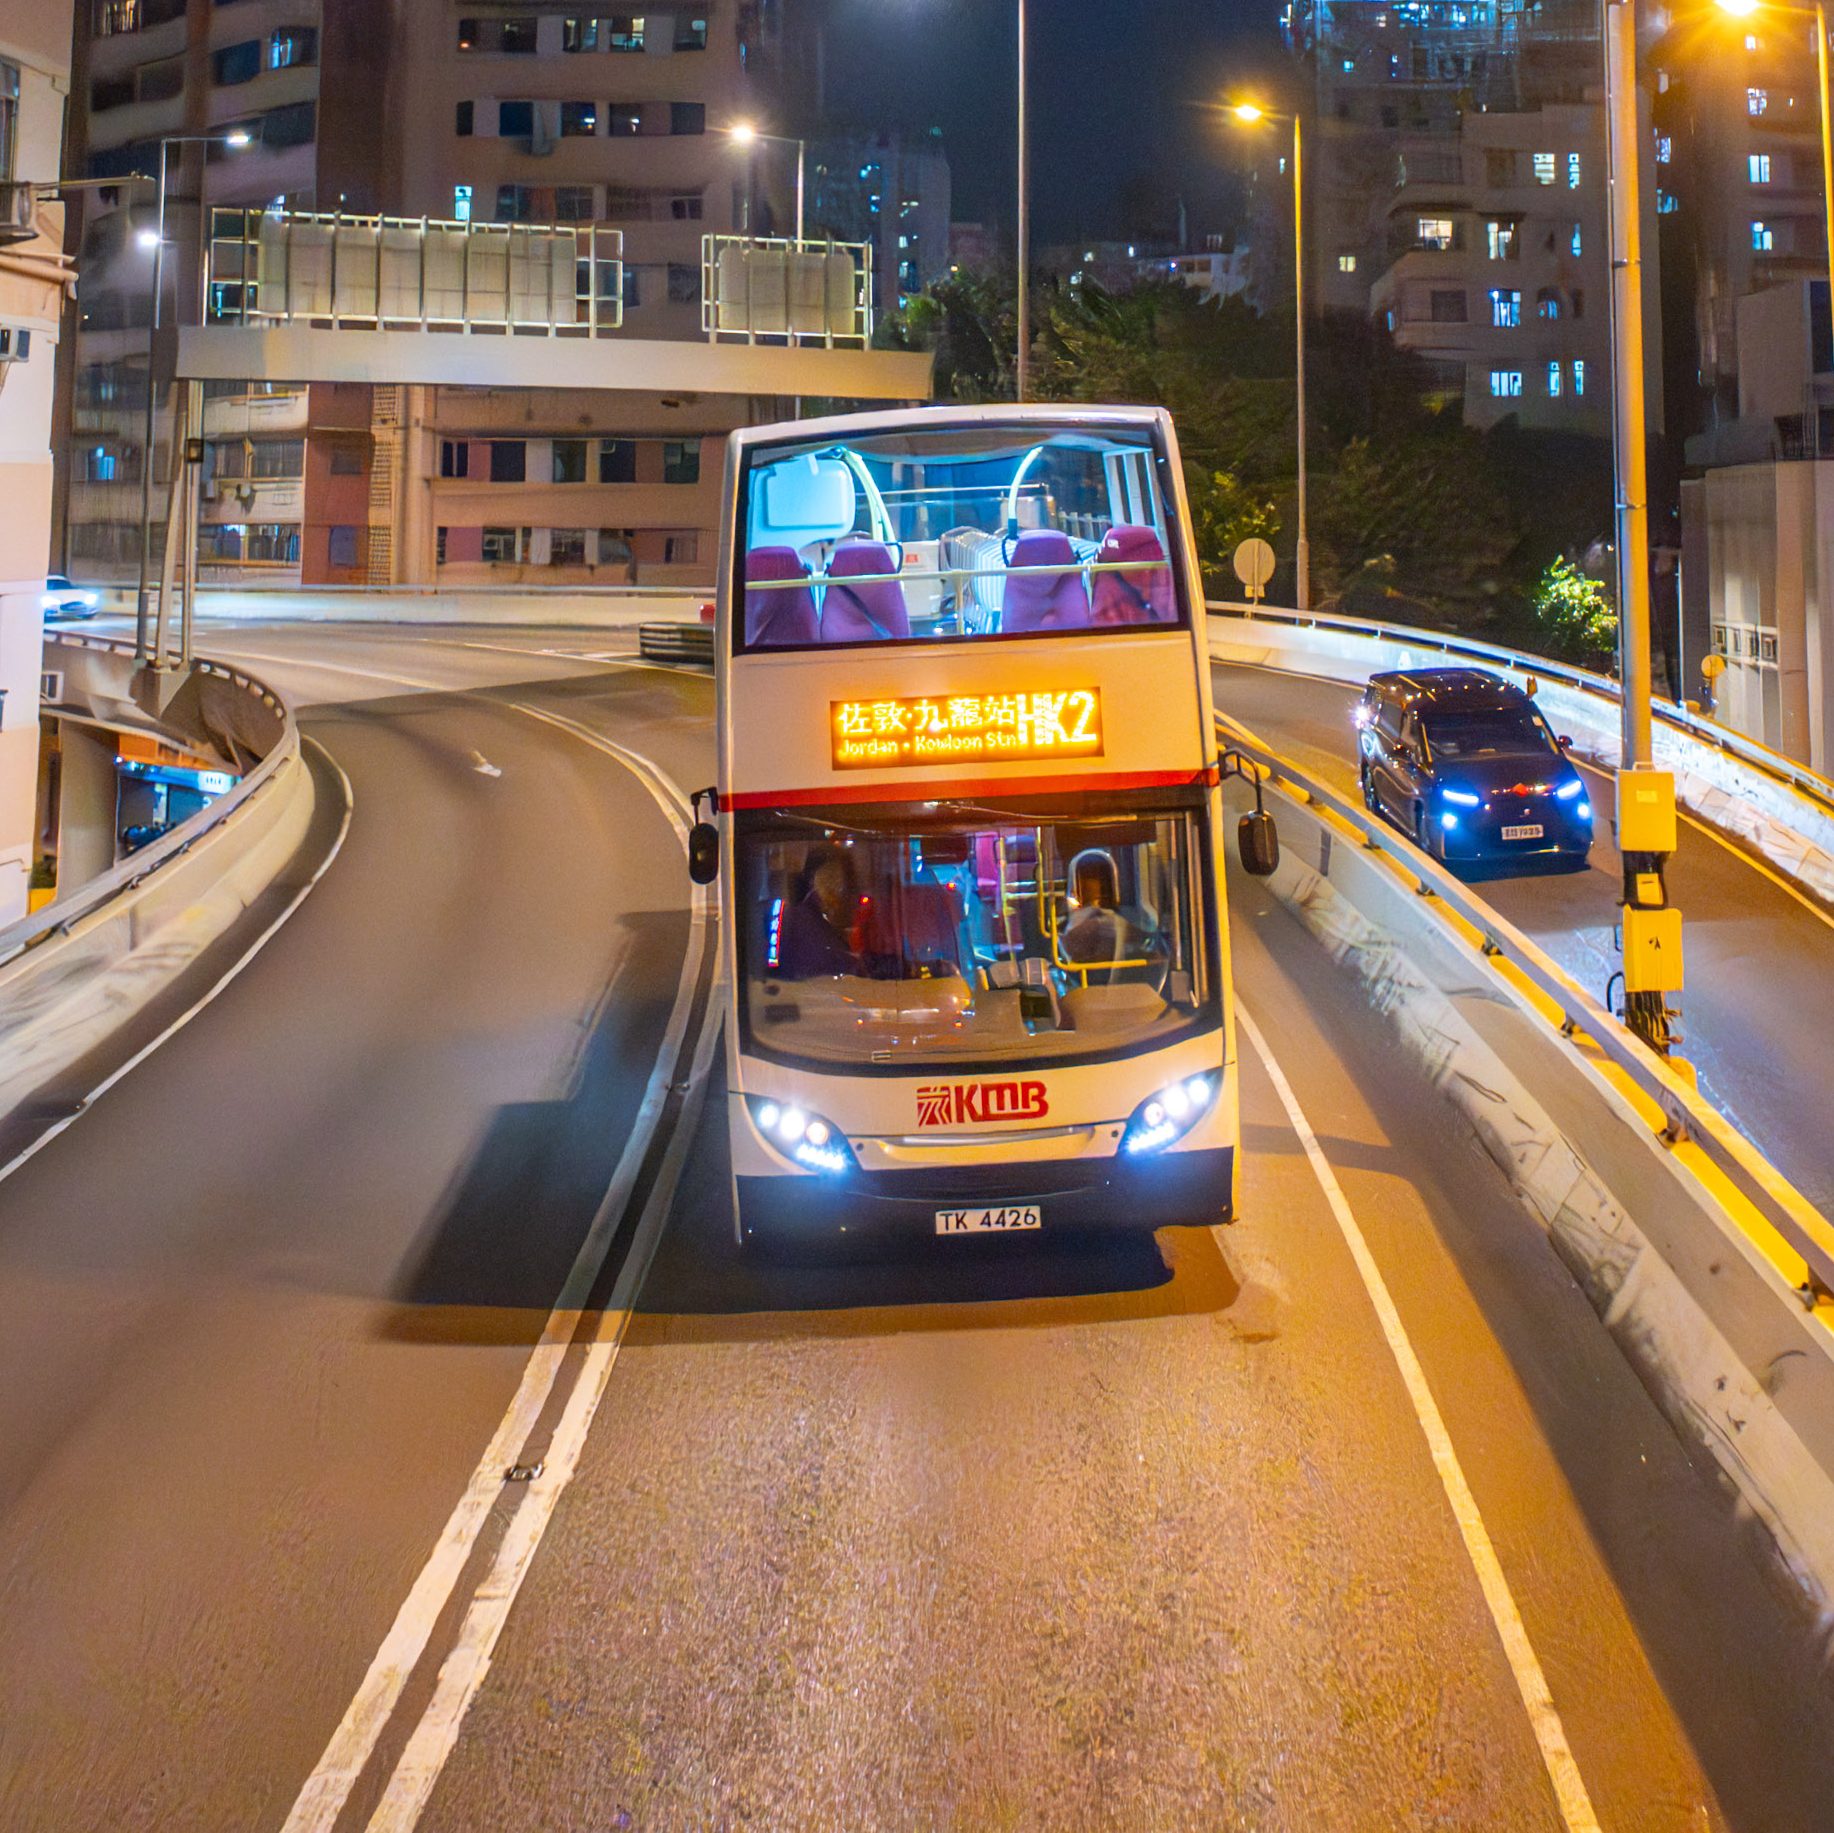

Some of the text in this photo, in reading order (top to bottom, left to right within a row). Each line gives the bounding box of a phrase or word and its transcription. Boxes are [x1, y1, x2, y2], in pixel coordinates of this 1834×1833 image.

[1015, 691, 1097, 745] HK2
[838, 730, 1017, 755] Jordan Kowloon Stn
[954, 1080, 1049, 1124] KMB
[938, 1208, 1037, 1231] TK 4426
